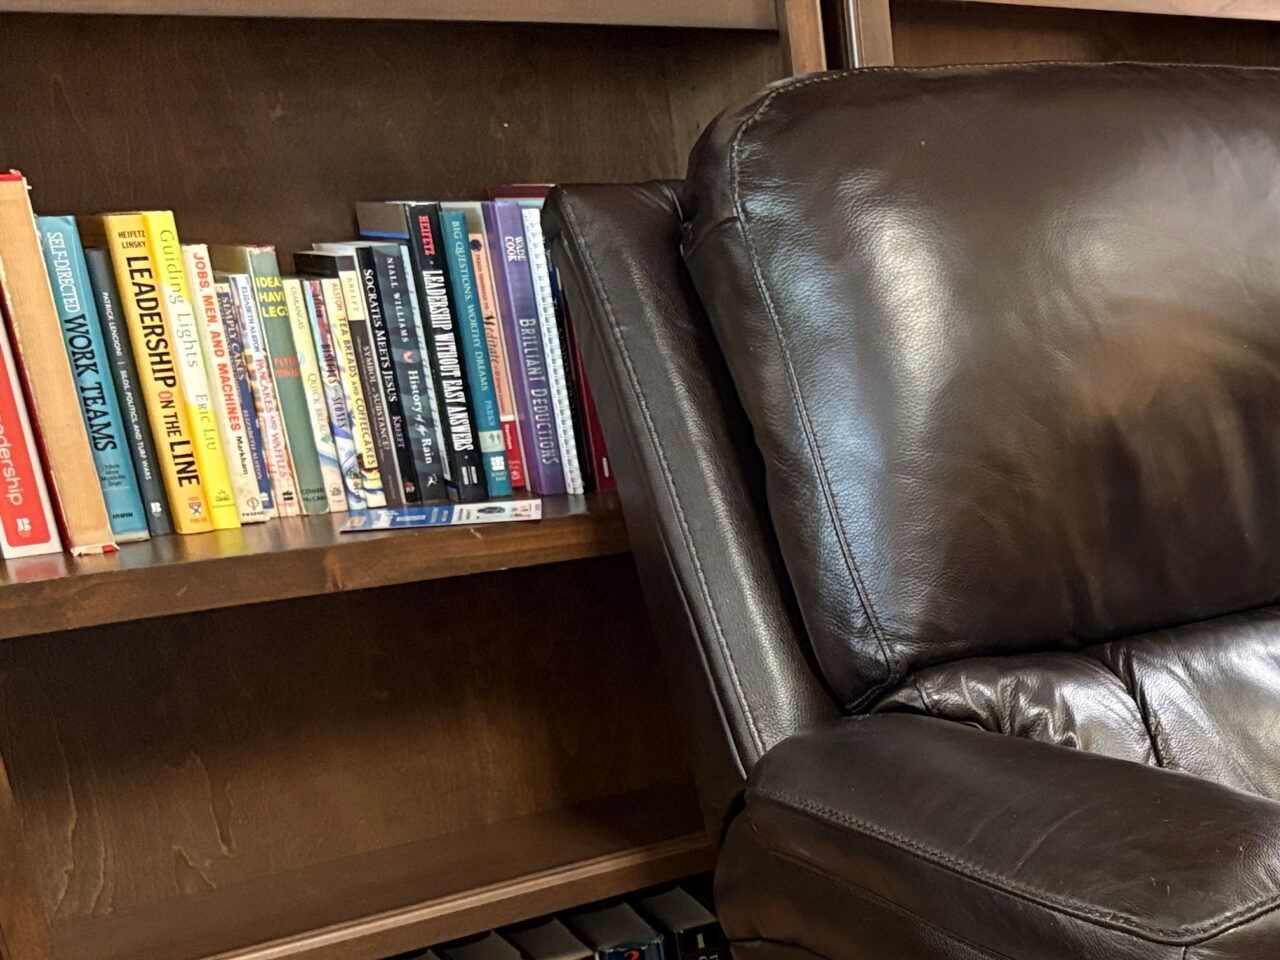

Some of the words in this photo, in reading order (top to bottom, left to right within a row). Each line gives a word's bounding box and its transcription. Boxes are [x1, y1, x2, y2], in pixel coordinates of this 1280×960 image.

[118, 230, 147, 239] HEIFETZ
[122, 241, 147, 249] LINSKY
[419, 215, 436, 256] HEIFETZ
[505, 236, 518, 262] COOK
[515, 236, 527, 261] WADE
[47, 232, 80, 313] SELF-DIRECTED
[193, 253, 210, 291] JOBS,
[160, 230, 184, 304] Guiding
[176, 313, 199, 368] Lights
[202, 295, 218, 327] MEN,
[332, 283, 344, 311] ALSTON
[364, 269, 383, 328] SOCRATES
[387, 257, 399, 288] NIALL
[393, 292, 409, 343] WILLIAMS
[422, 269, 453, 330] LEADERSHIP
[452, 221, 462, 239] BIG
[467, 304, 481, 348] WORTHY
[475, 351, 490, 392] DREAMS
[102, 292, 114, 320] PATRICK
[109, 322, 123, 356] LENCIONI
[126, 256, 177, 389] LEADERSHIP
[221, 297, 237, 340] SIMPLY
[231, 343, 245, 380] CAKES
[339, 317, 350, 336] TEA
[484, 312, 499, 364] Meditate
[64, 313, 99, 378] WORK
[210, 330, 225, 358] AND
[343, 340, 357, 378] BREADS
[375, 329, 391, 368] MEETS
[434, 332, 462, 378] WITHOUT
[520, 319, 545, 382] BRILLIANT
[363, 345, 377, 386] SYMBOL
[382, 369, 397, 402] JESUS
[158, 391, 175, 409] ON
[196, 394, 211, 423] ERIC
[217, 363, 241, 432] MACHINES
[308, 373, 321, 405] QUICK
[442, 379, 467, 404] EASY
[80, 382, 117, 453] TEAMS
[163, 412, 183, 438] THE
[255, 359, 275, 413] PANCAKES
[272, 433, 288, 478] WAFFLES
[332, 396, 348, 428] SCONES
[355, 398, 376, 466] COFFEECAKES
[407, 370, 424, 413] History
[421, 438, 434, 464] Rain
[447, 406, 474, 452] ANSWERS
[531, 388, 560, 465] DEDUCTIONS
[133, 425, 142, 443] AND
[138, 442, 148, 460] TURF
[203, 429, 217, 451] LIU
[0, 416, 23, 505] dership
[141, 460, 152, 480] WARS
[170, 440, 201, 488] LINE
[236, 436, 248, 475] Markham
